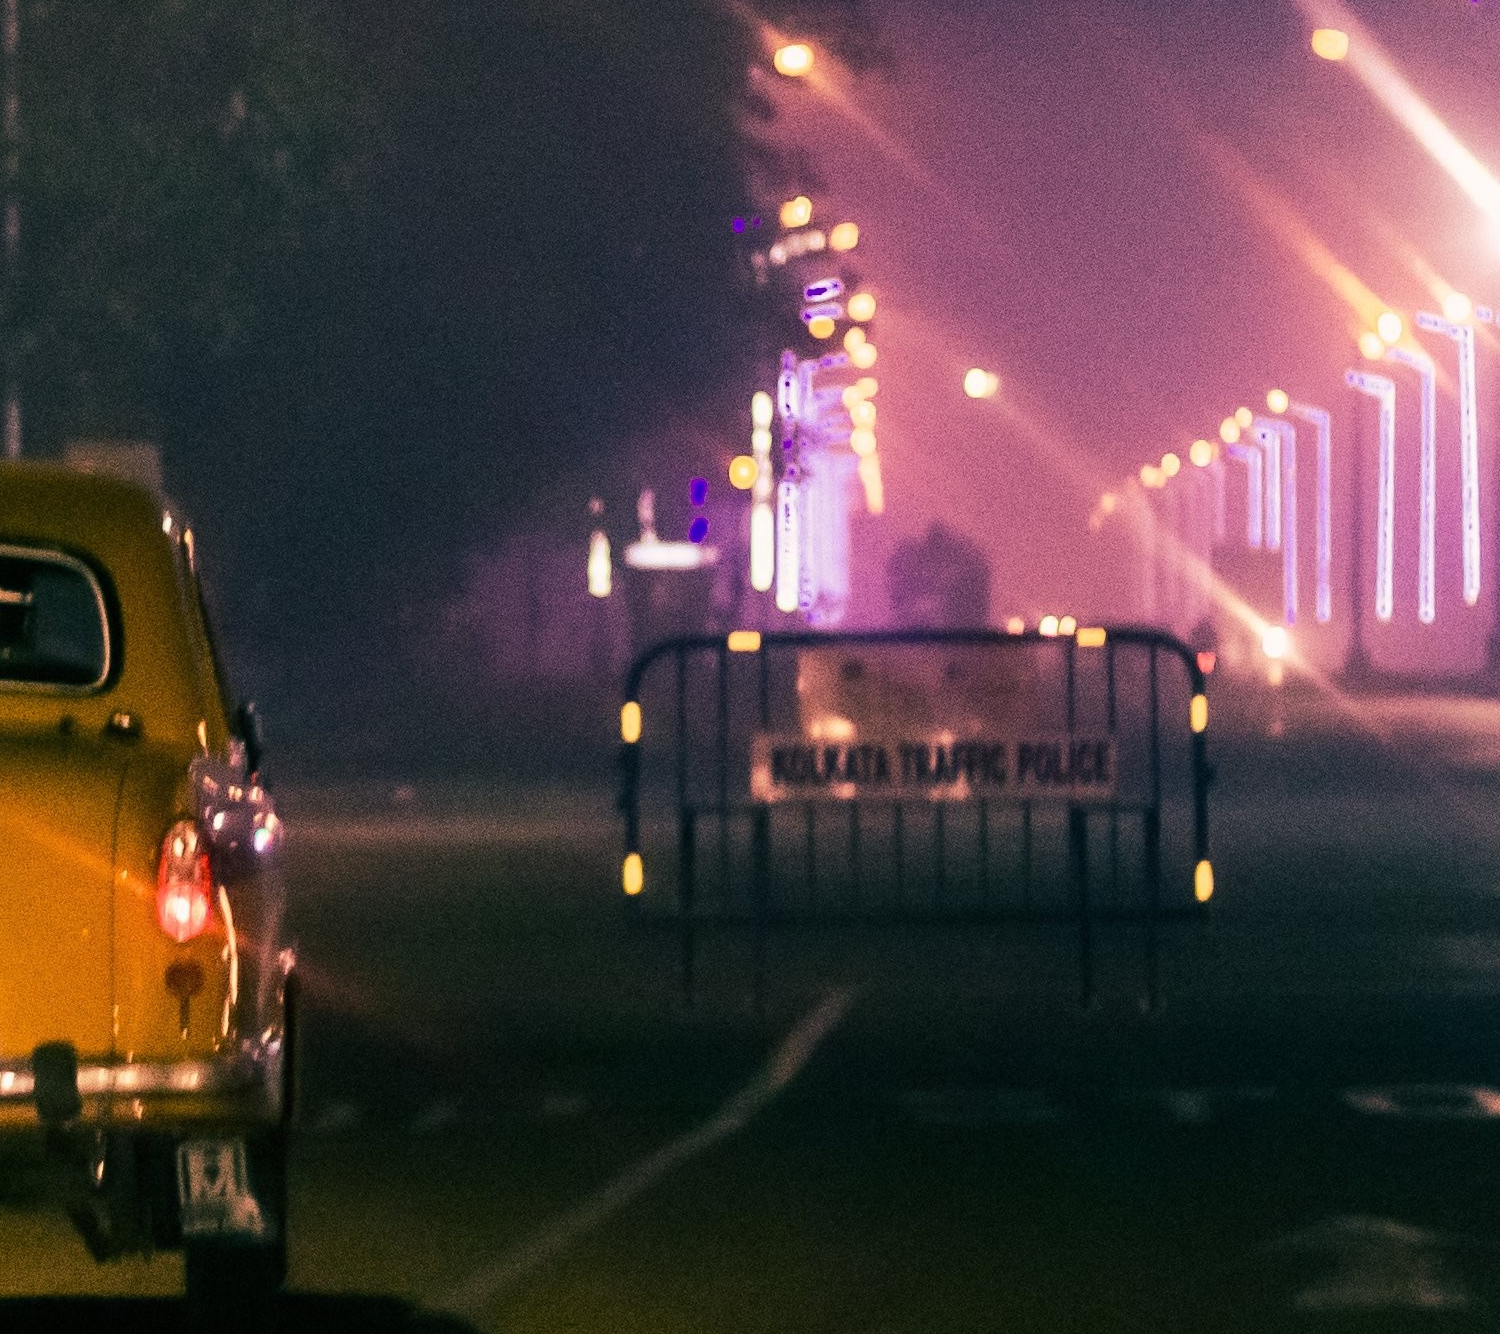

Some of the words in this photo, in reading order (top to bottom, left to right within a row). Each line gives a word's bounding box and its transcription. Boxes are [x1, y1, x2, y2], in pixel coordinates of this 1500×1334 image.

[771, 742, 889, 785] KOLKATA
[899, 740, 1006, 784] TRAFFIC
[1017, 740, 1111, 784] POLICE
